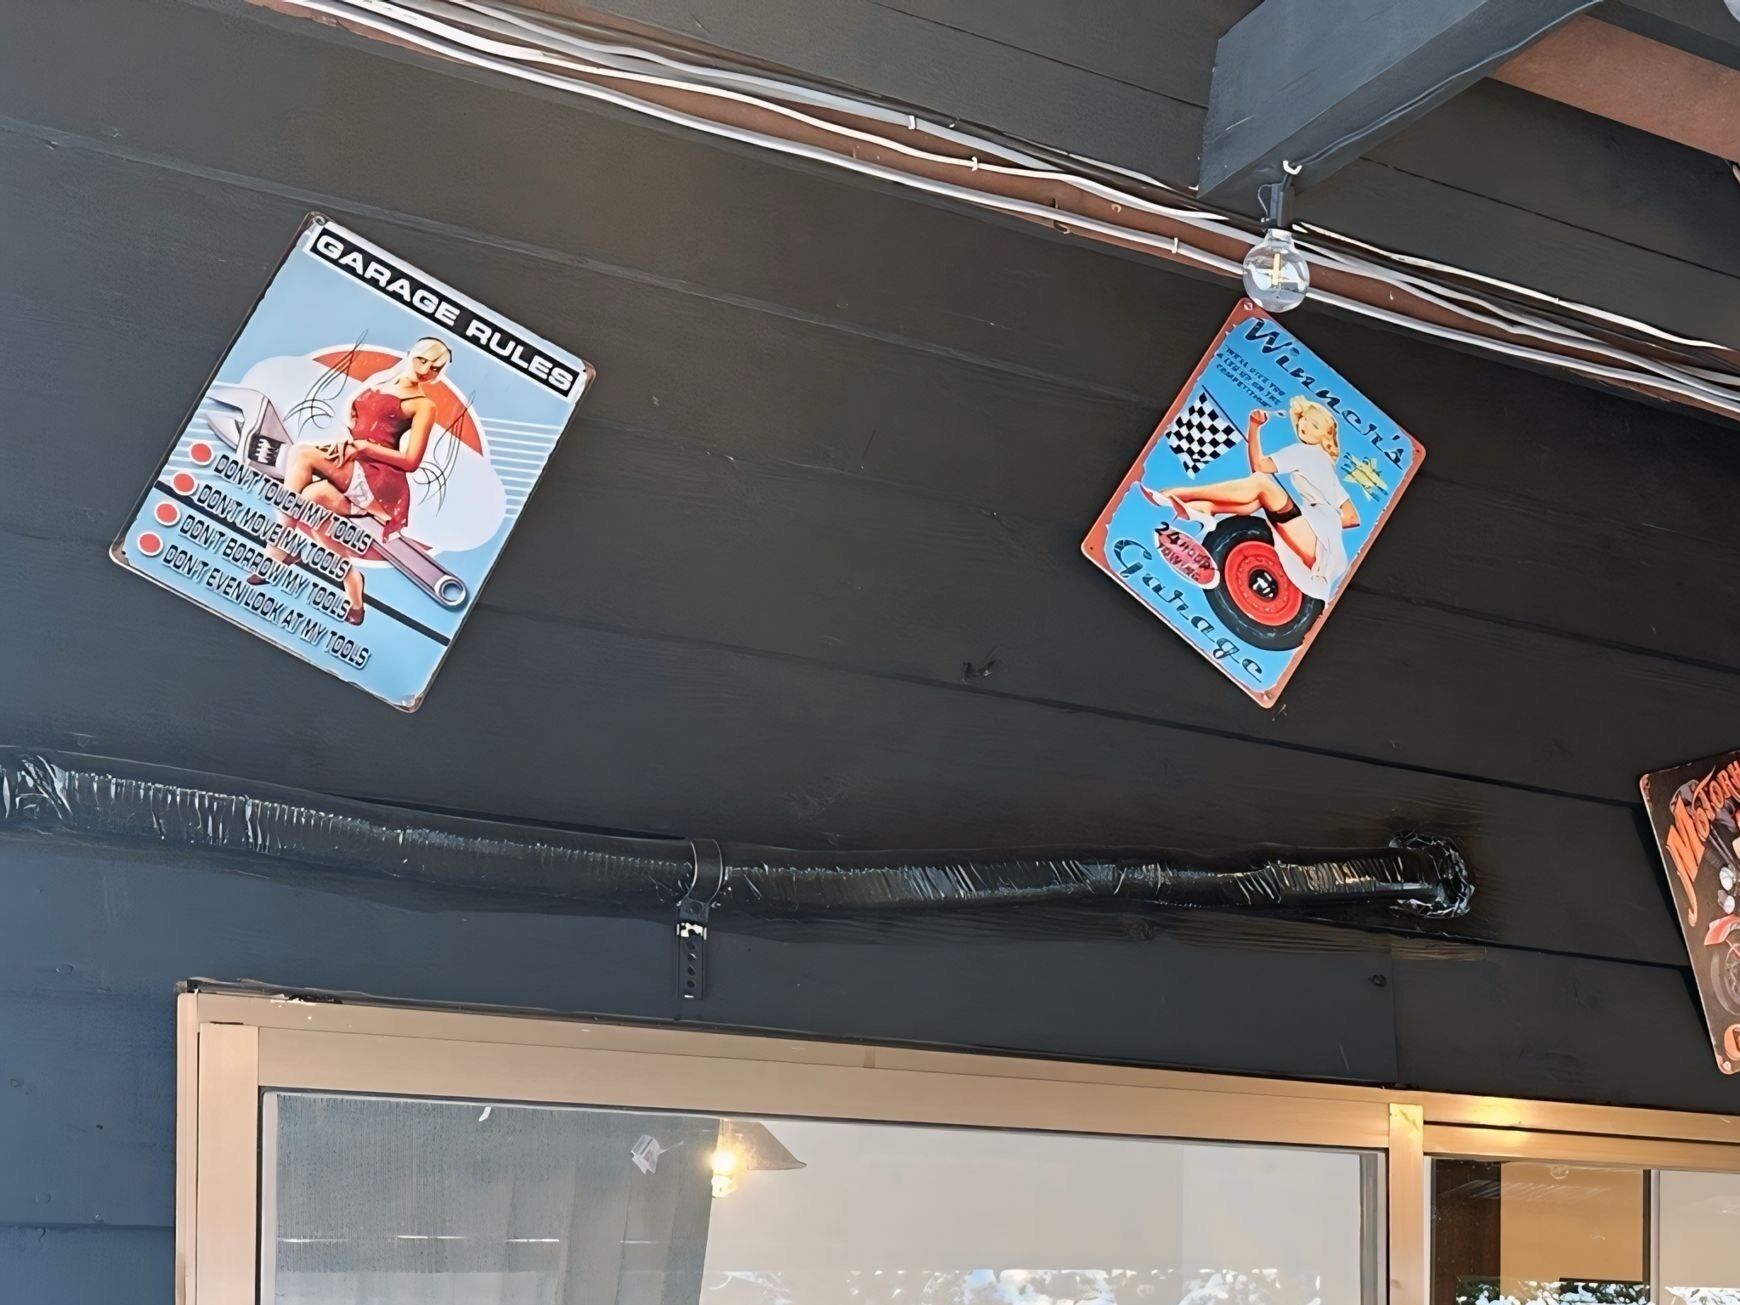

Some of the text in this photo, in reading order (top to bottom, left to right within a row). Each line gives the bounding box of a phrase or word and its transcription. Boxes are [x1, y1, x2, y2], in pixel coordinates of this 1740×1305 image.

[316, 233, 574, 392] GARAGE RULES
[197, 484, 350, 580] DON'T MOVE MY TOOLS
[214, 454, 372, 553] DON'T TOUCH MY TOOLS
[1155, 521, 1181, 545] 24
[163, 544, 370, 668] DON'T EVEN LOOK AT MY TOOLS
[180, 514, 351, 620] DON'T BORROW MY TOOLS
[1113, 539, 1264, 682] Garage
